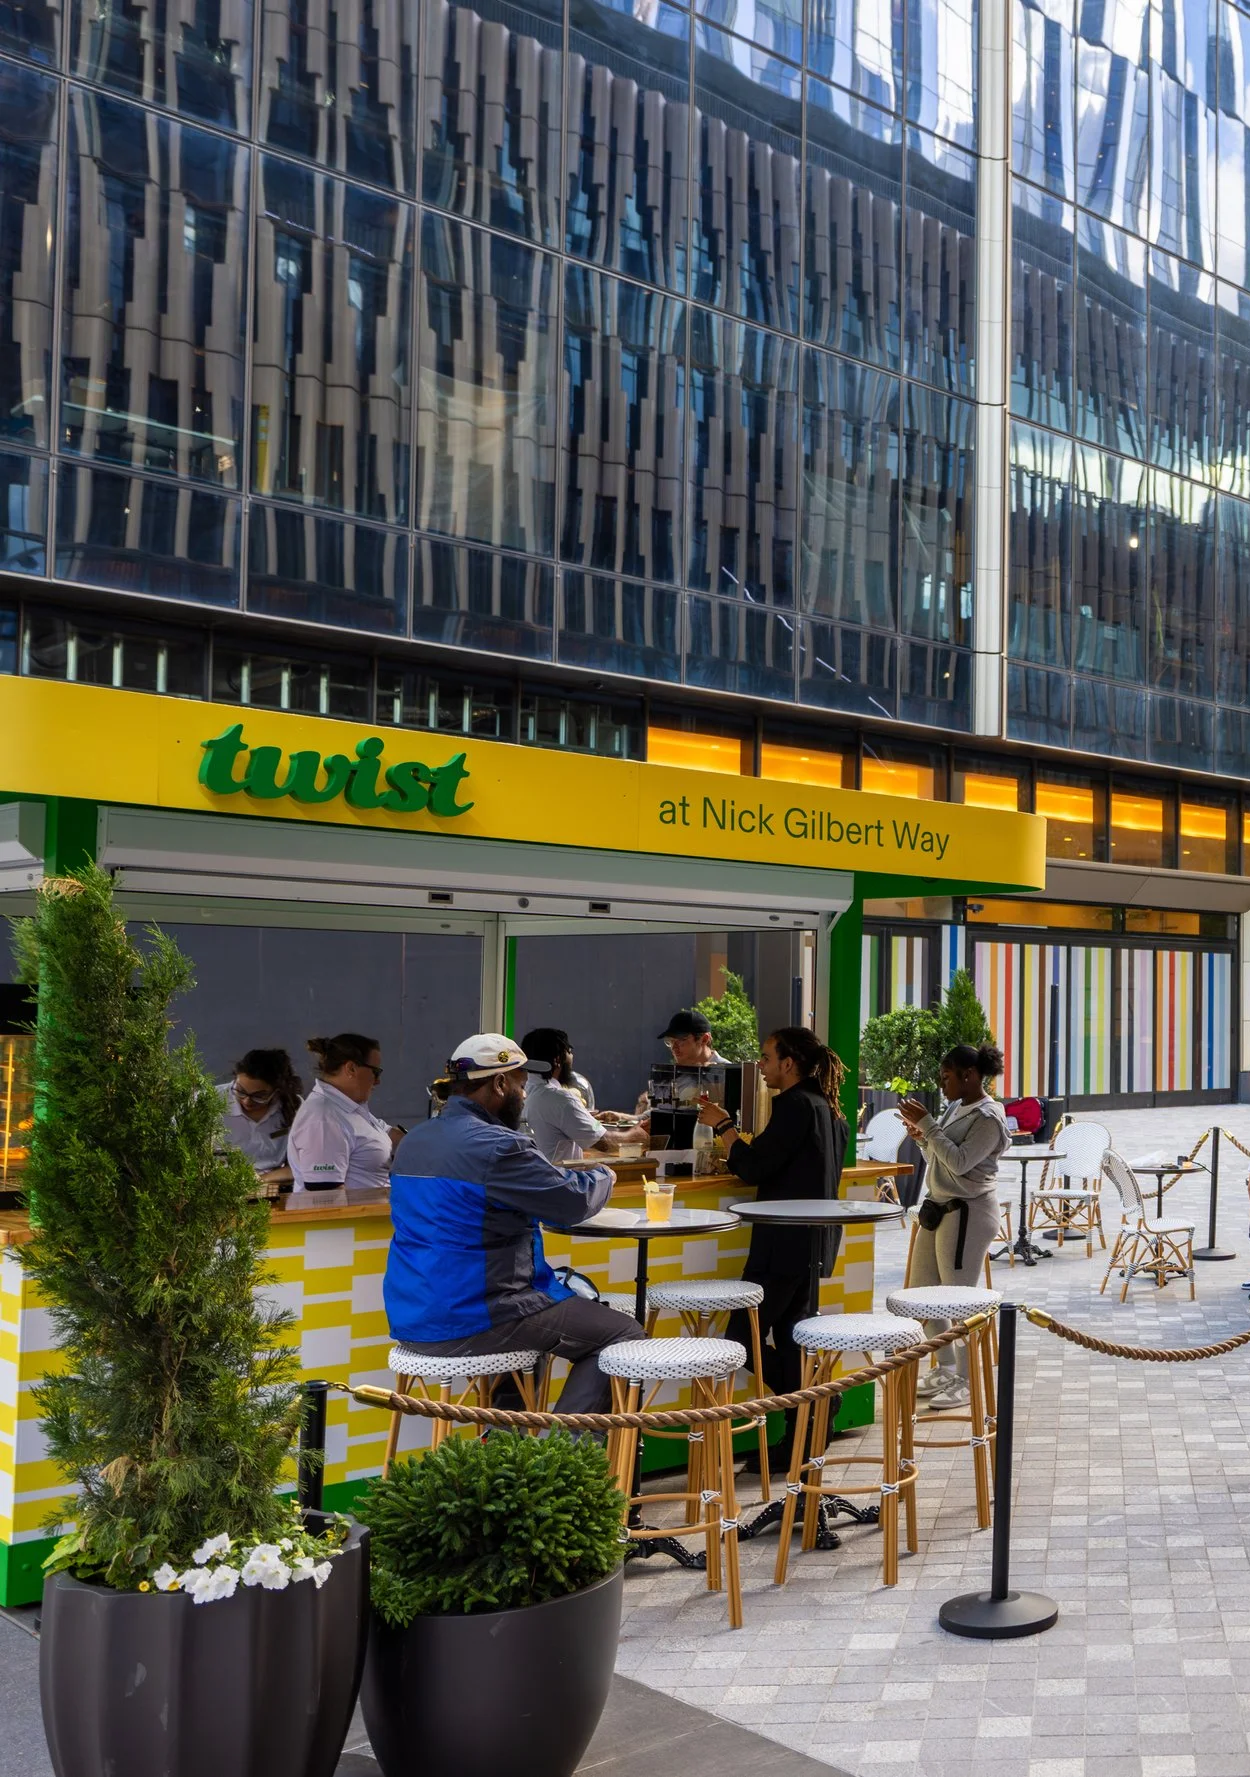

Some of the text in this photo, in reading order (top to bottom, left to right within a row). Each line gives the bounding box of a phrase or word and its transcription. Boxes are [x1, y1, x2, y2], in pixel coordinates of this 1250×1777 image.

[198, 723, 475, 818] twist
[659, 796, 950, 861] at Nick Gilbert Way
